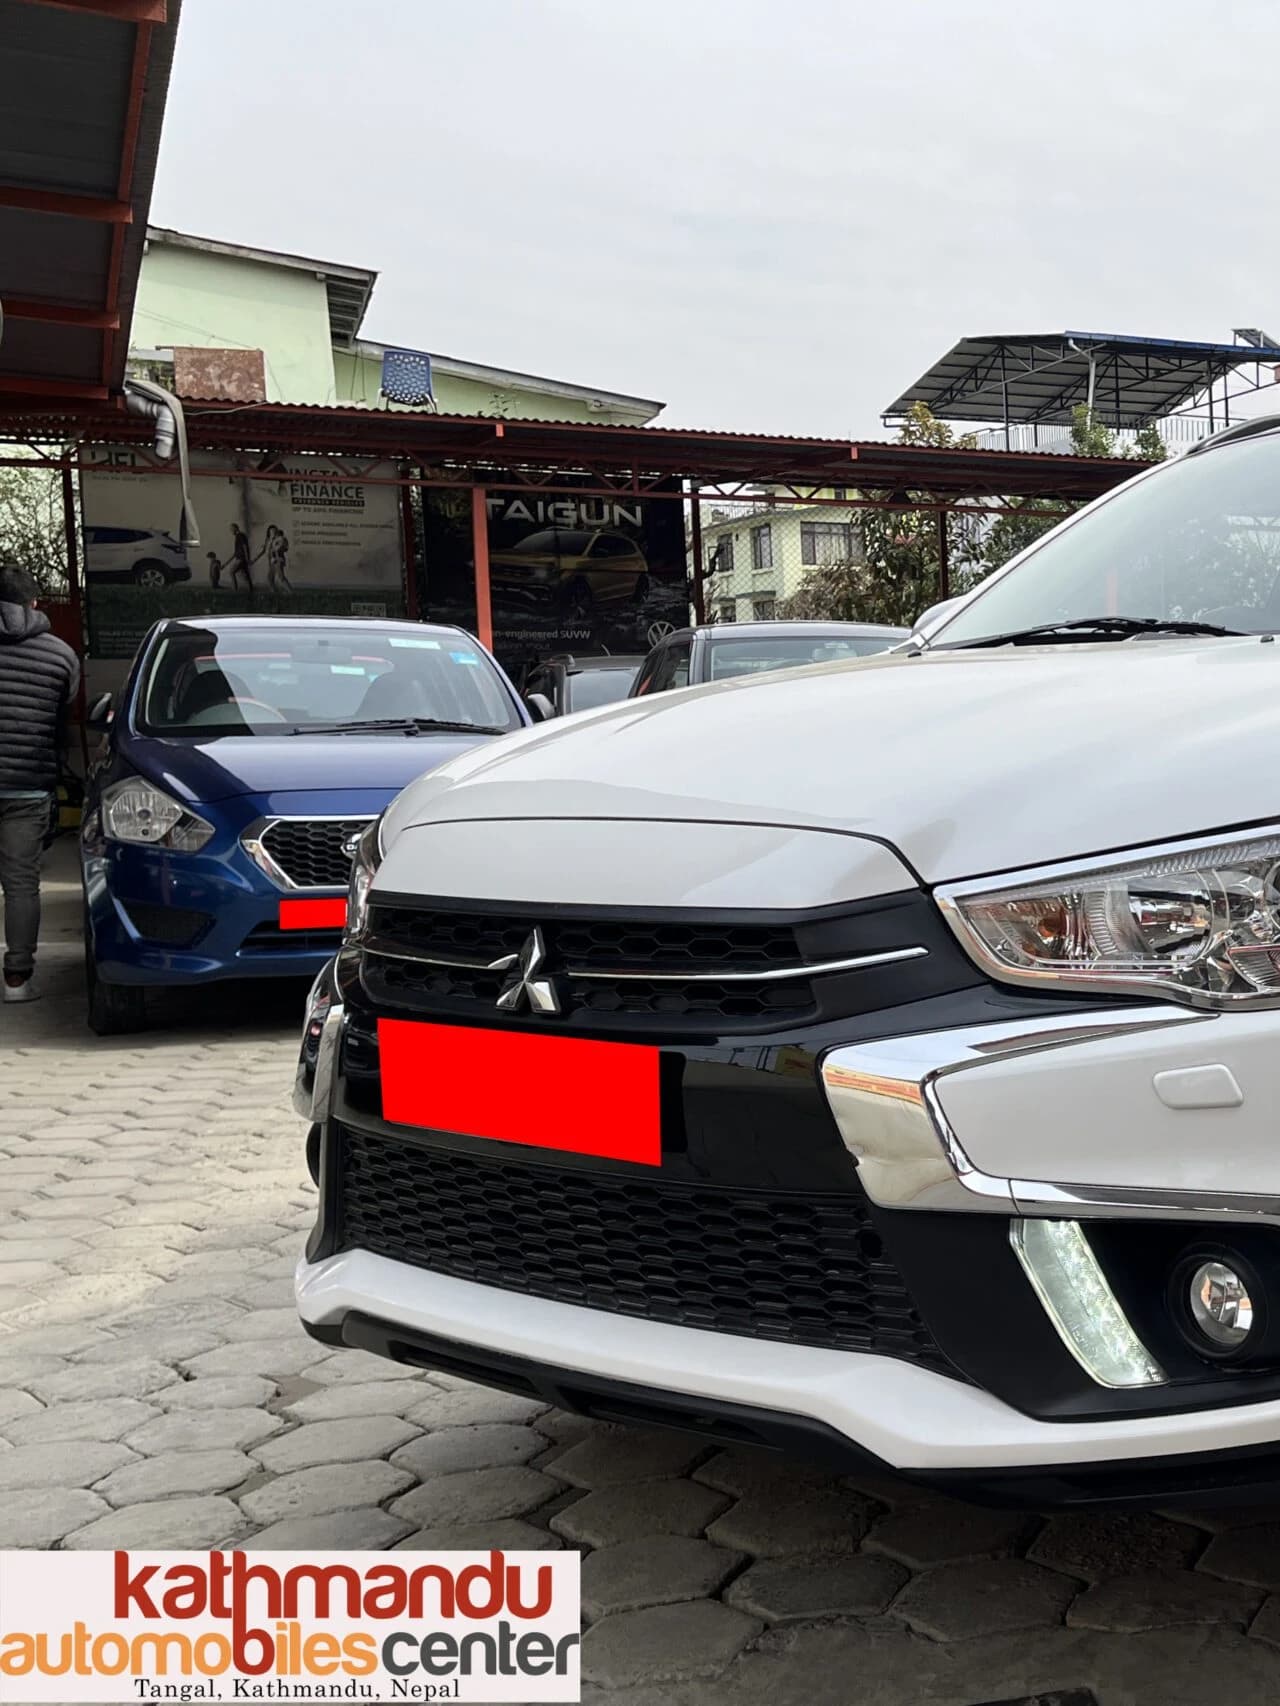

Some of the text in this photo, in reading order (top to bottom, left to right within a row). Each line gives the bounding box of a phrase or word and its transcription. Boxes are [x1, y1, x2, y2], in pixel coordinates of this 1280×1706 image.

[290, 484, 364, 499] FINANCE
[486, 498, 643, 528] TAIGUN
[560, 630, 591, 640] SUVW
